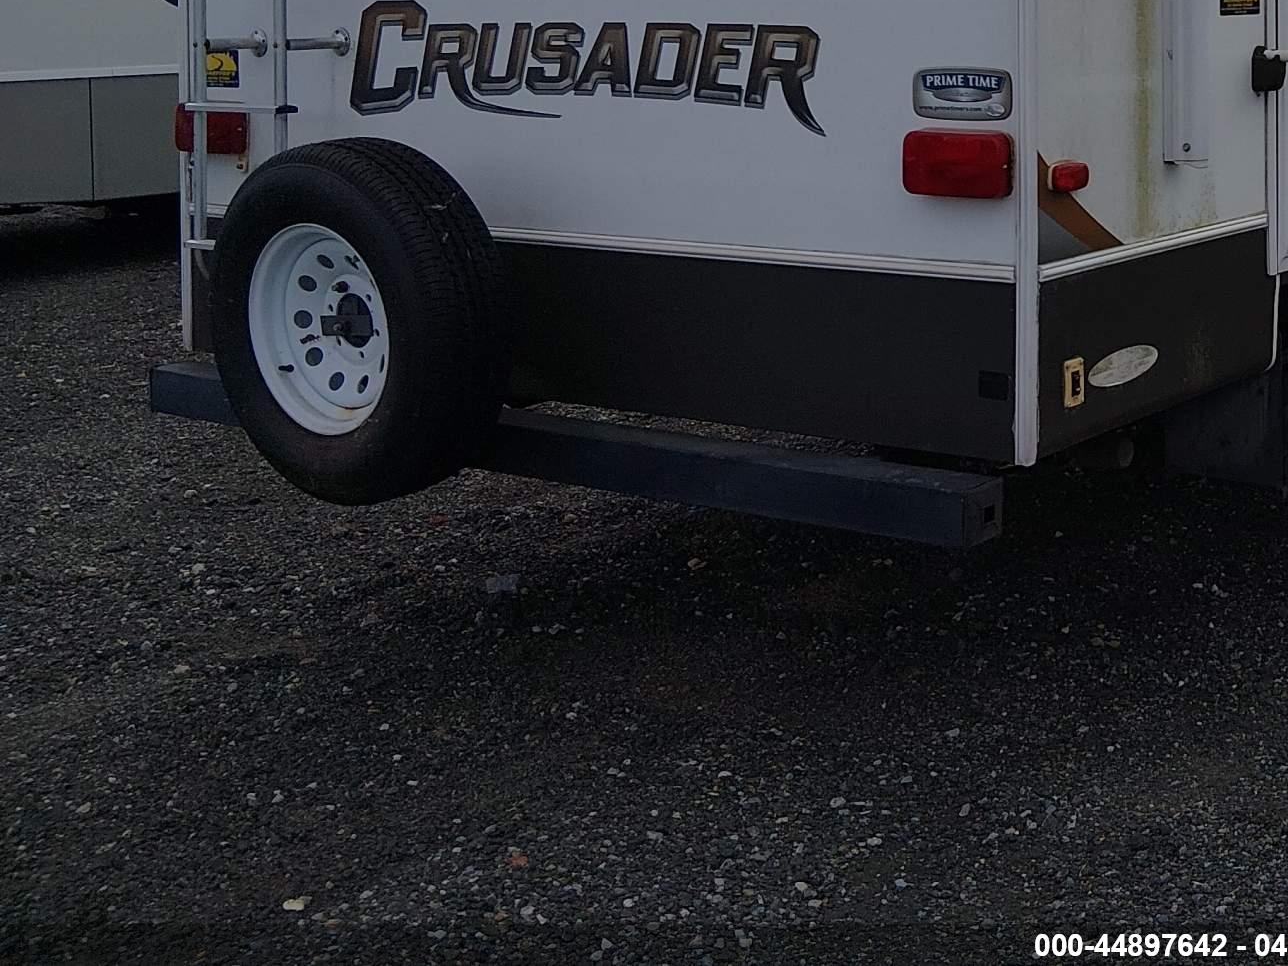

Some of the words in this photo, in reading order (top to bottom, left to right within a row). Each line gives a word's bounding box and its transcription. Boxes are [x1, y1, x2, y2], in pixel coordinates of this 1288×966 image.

[350, 0, 826, 137] CRUSADER
[926, 74, 965, 87] PRIME
[967, 75, 999, 89] TIME
